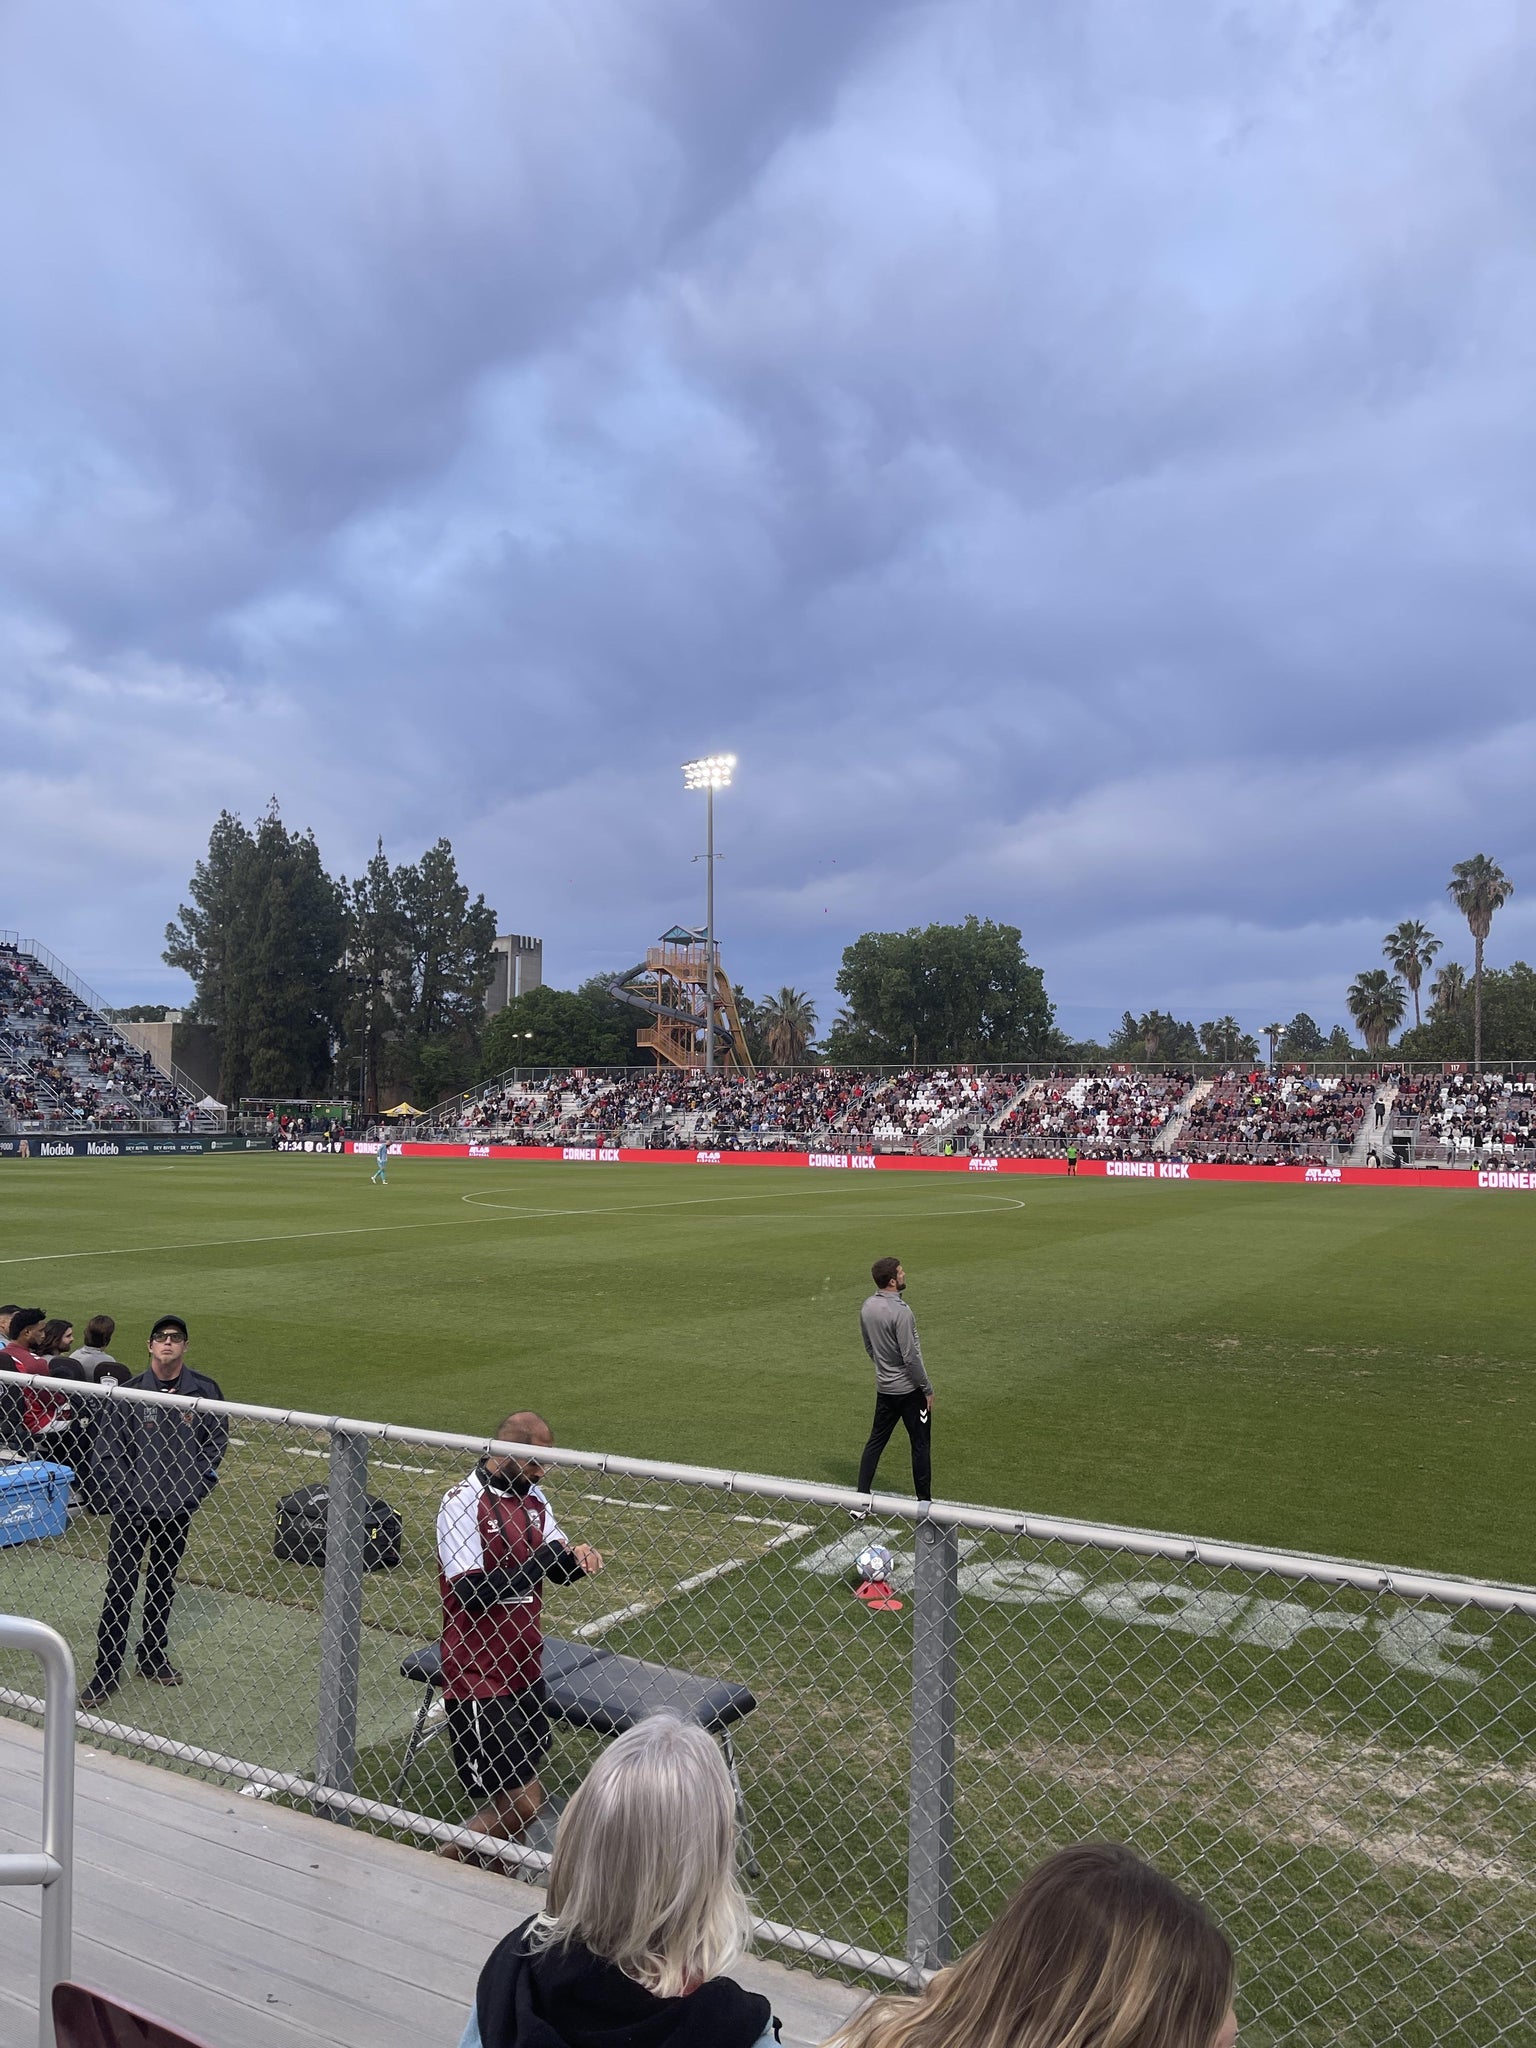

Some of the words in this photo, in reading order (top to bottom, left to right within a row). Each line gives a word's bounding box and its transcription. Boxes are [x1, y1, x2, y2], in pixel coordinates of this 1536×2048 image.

[961, 1066, 969, 1074] 114
[1118, 1065, 1126, 1073] 115
[1450, 1064, 1460, 1072] 117
[40, 1142, 74, 1156] Modelo
[87, 1141, 119, 1155] Modelo
[278, 1141, 303, 1151] 31:34
[315, 1142, 332, 1153] 0-1
[353, 1142, 381, 1154] CORNE
[563, 1148, 596, 1160] CORNER
[599, 1149, 620, 1161] KICK
[696, 1151, 721, 1159] ATLAS
[808, 1153, 848, 1168] CORNER
[851, 1155, 876, 1169] KICK
[969, 1158, 998, 1166] ATLAS
[1106, 1161, 1155, 1177] CORNER
[1159, 1163, 1190, 1179] KICK
[1305, 1168, 1342, 1177] ATLAS
[1478, 1171, 1536, 1189] CORNER
